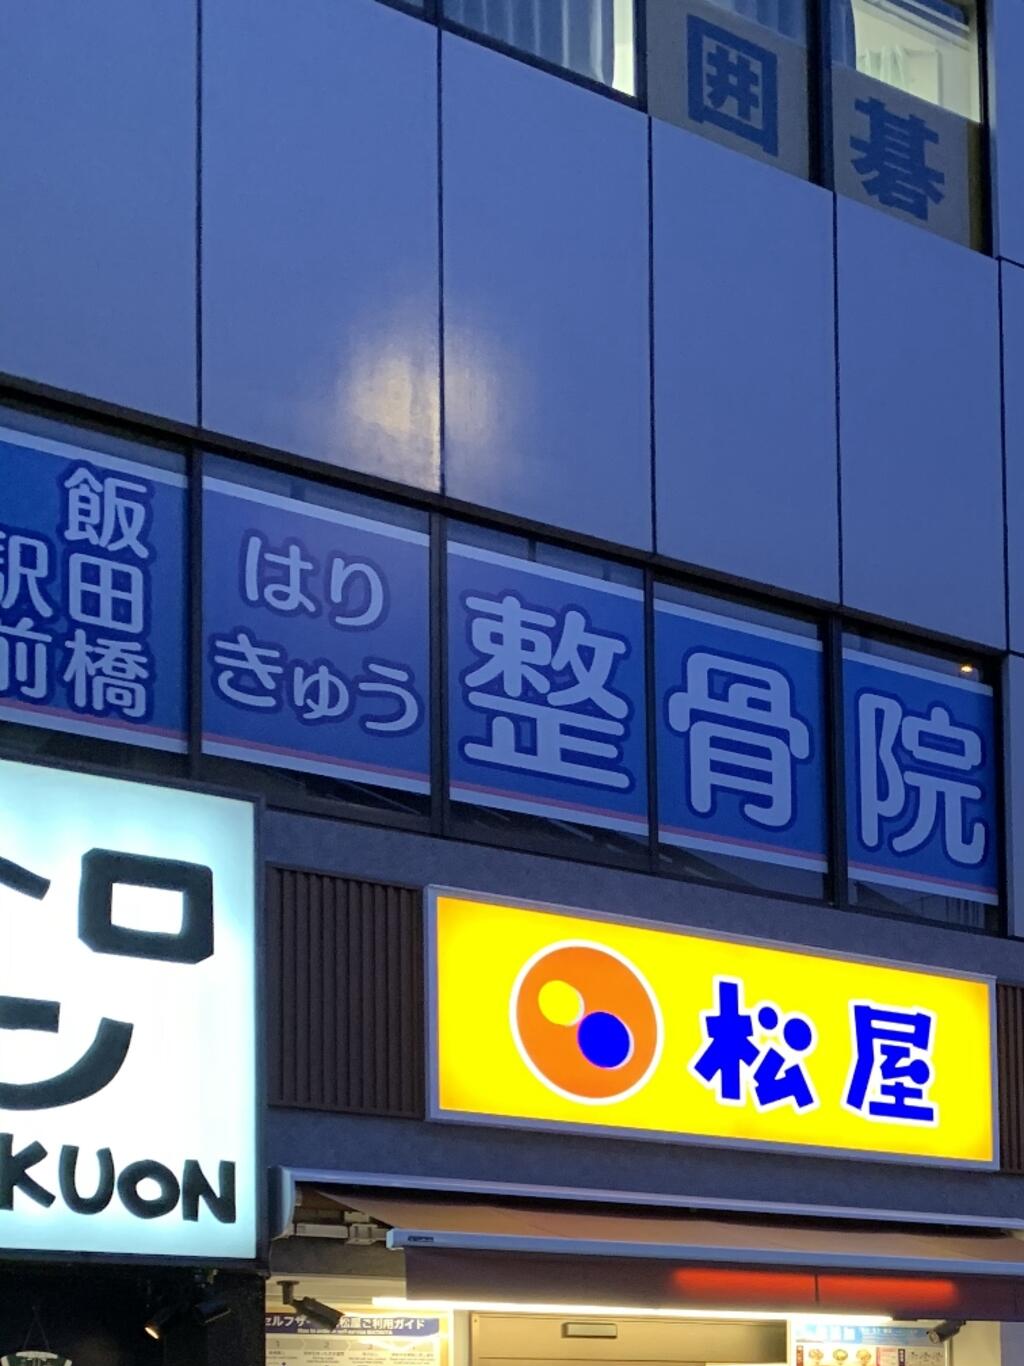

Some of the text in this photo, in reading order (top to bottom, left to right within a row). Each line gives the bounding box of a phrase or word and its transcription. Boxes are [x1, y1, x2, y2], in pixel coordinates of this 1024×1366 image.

[63, 466, 149, 718] 飯田橋
[245, 536, 385, 627] はり
[213, 633, 419, 732] きゅう
[463, 595, 987, 865] 整骨院
[693, 980, 936, 1122] 松屋
